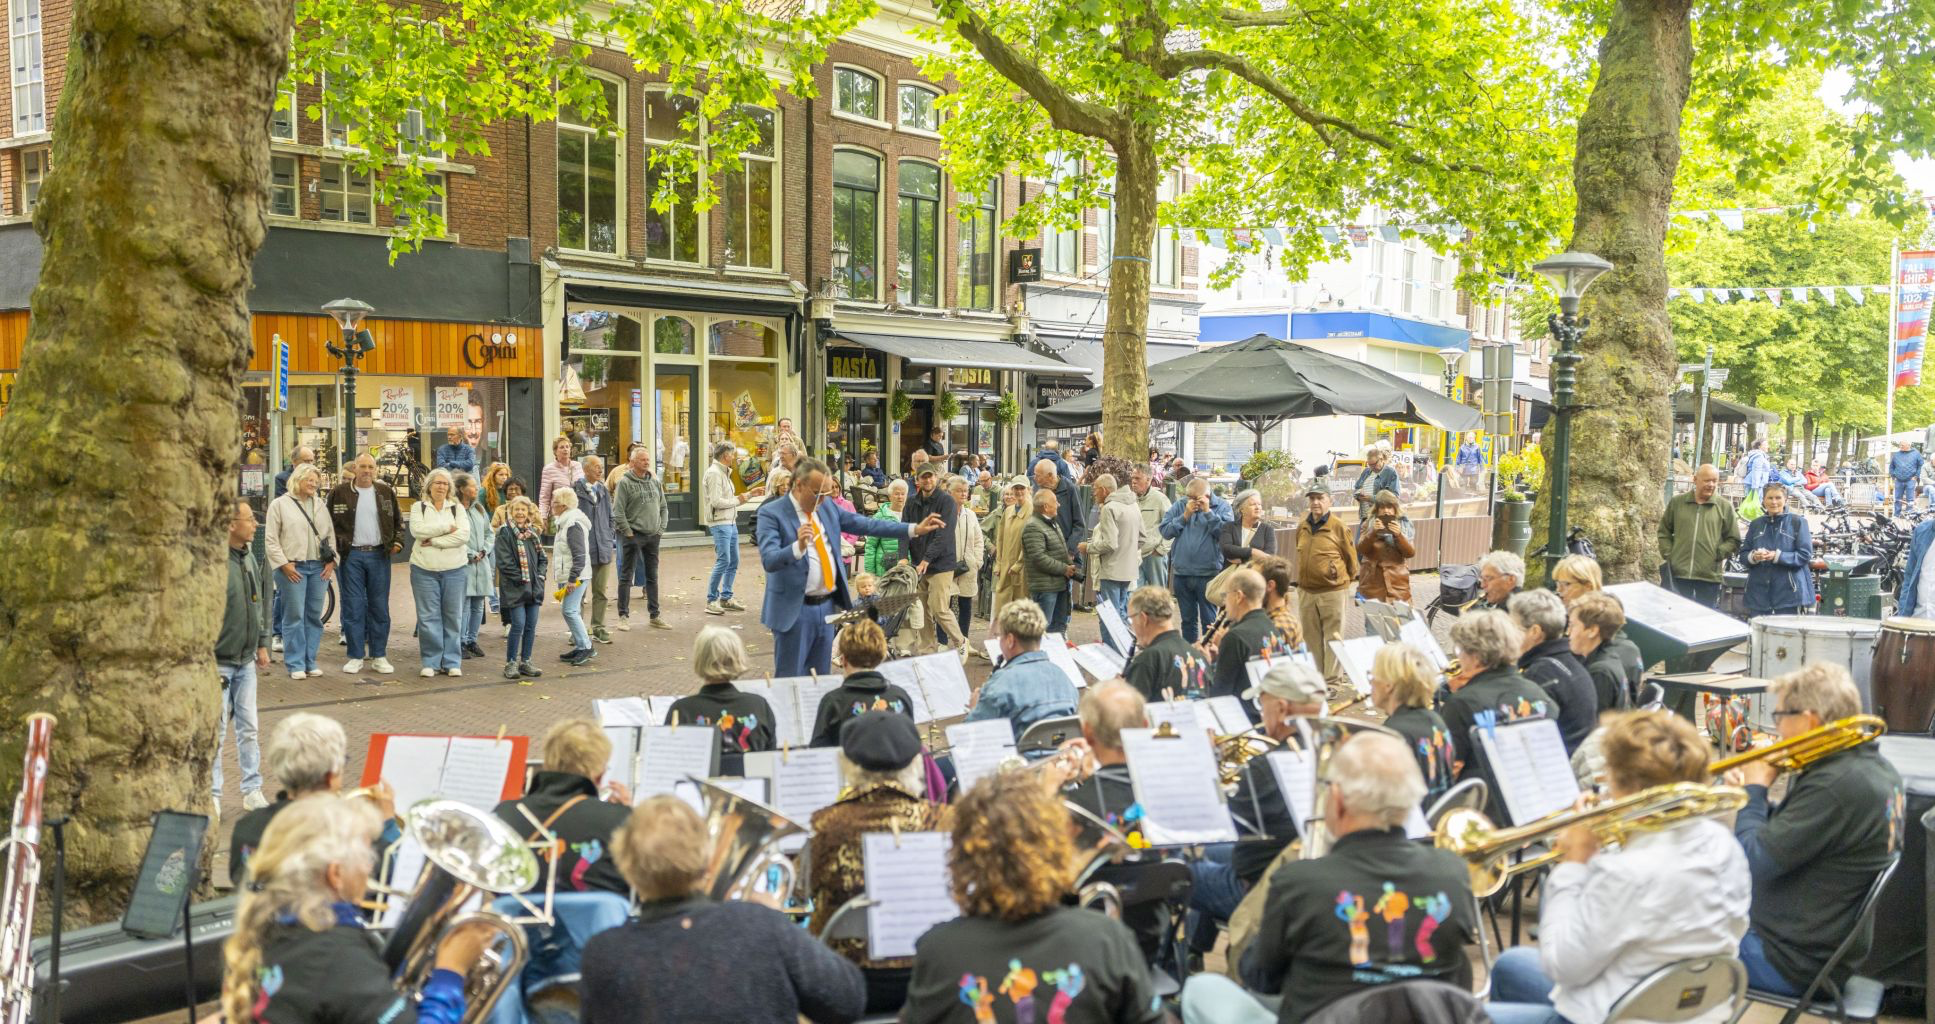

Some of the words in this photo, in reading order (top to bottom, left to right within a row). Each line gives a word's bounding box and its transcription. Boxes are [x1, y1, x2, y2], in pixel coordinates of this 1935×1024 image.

[463, 333, 517, 369] Copini
[832, 356, 877, 379] BASTA
[953, 368, 992, 384] BASTA
[1041, 387, 1083, 397] BINNENKORT
[382, 402, 409, 414] 20%
[438, 403, 464, 414] 20%
